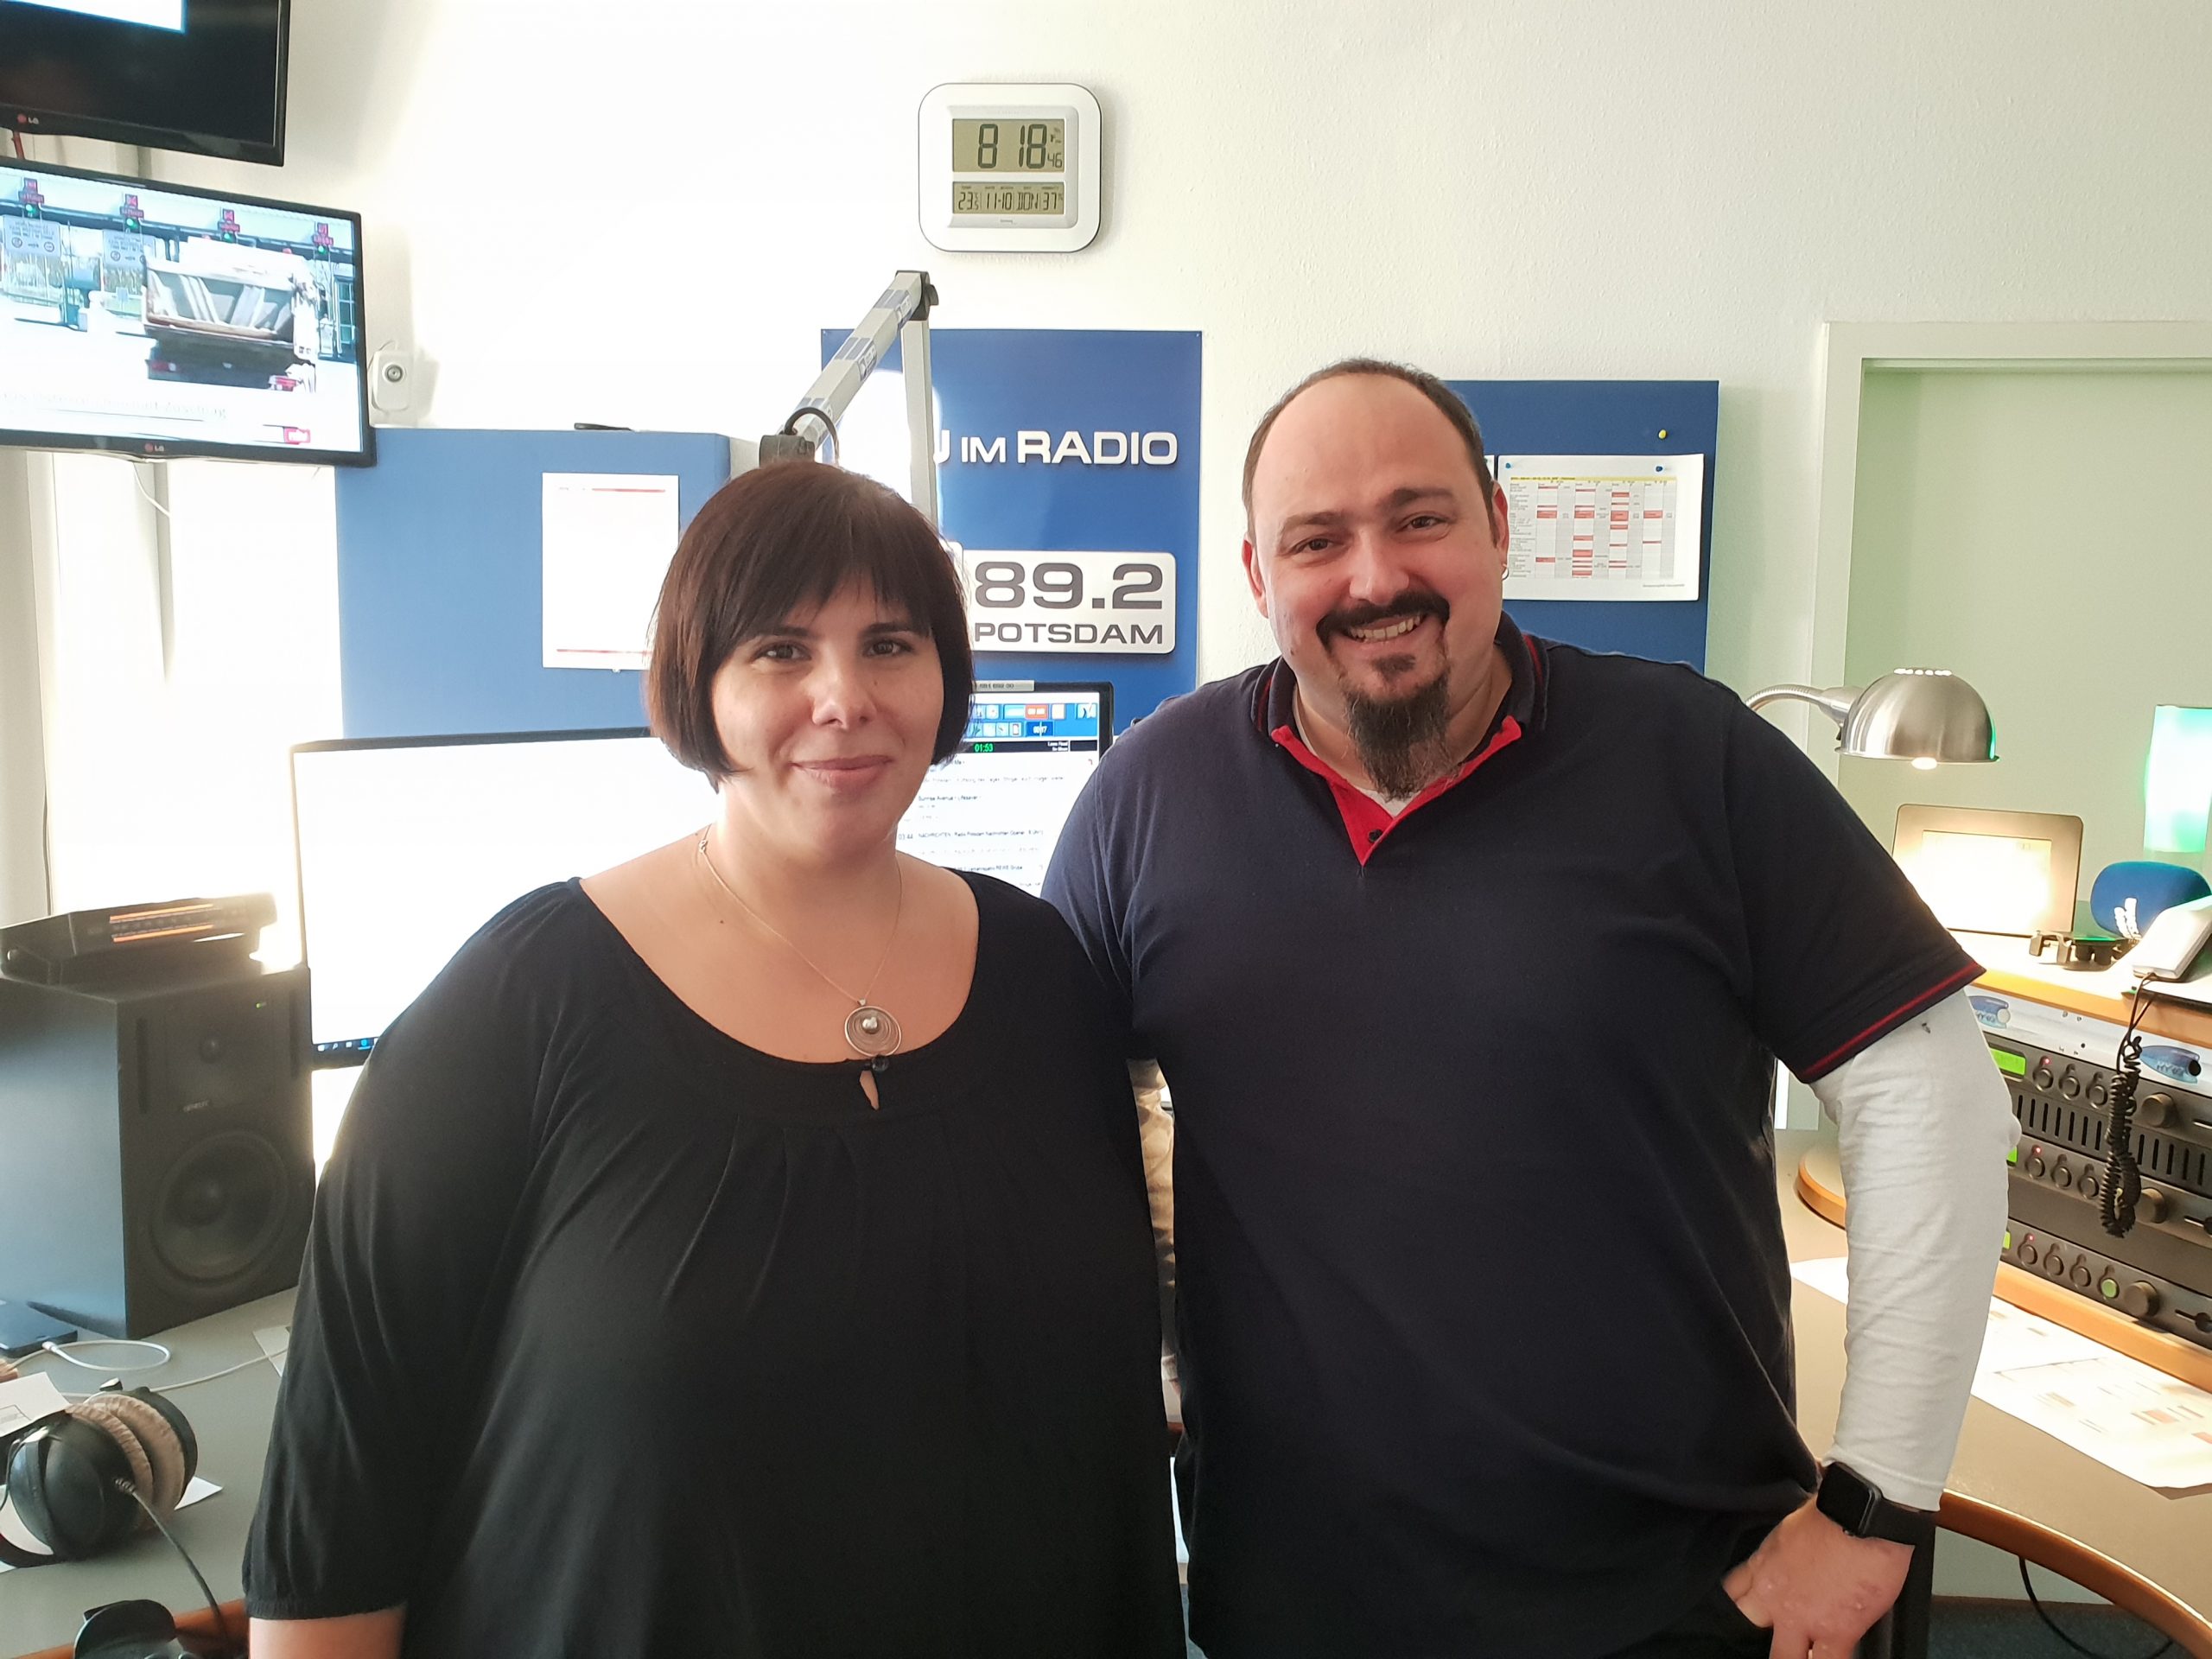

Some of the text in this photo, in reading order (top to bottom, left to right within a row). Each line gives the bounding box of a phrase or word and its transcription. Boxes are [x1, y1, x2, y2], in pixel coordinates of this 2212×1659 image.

[978, 124, 1063, 168] 8 18 46
[961, 436, 1007, 463] IM
[1017, 430, 1178, 465] RADIO
[975, 561, 1163, 609] 89.2
[975, 622, 1163, 644] POTSDAM
